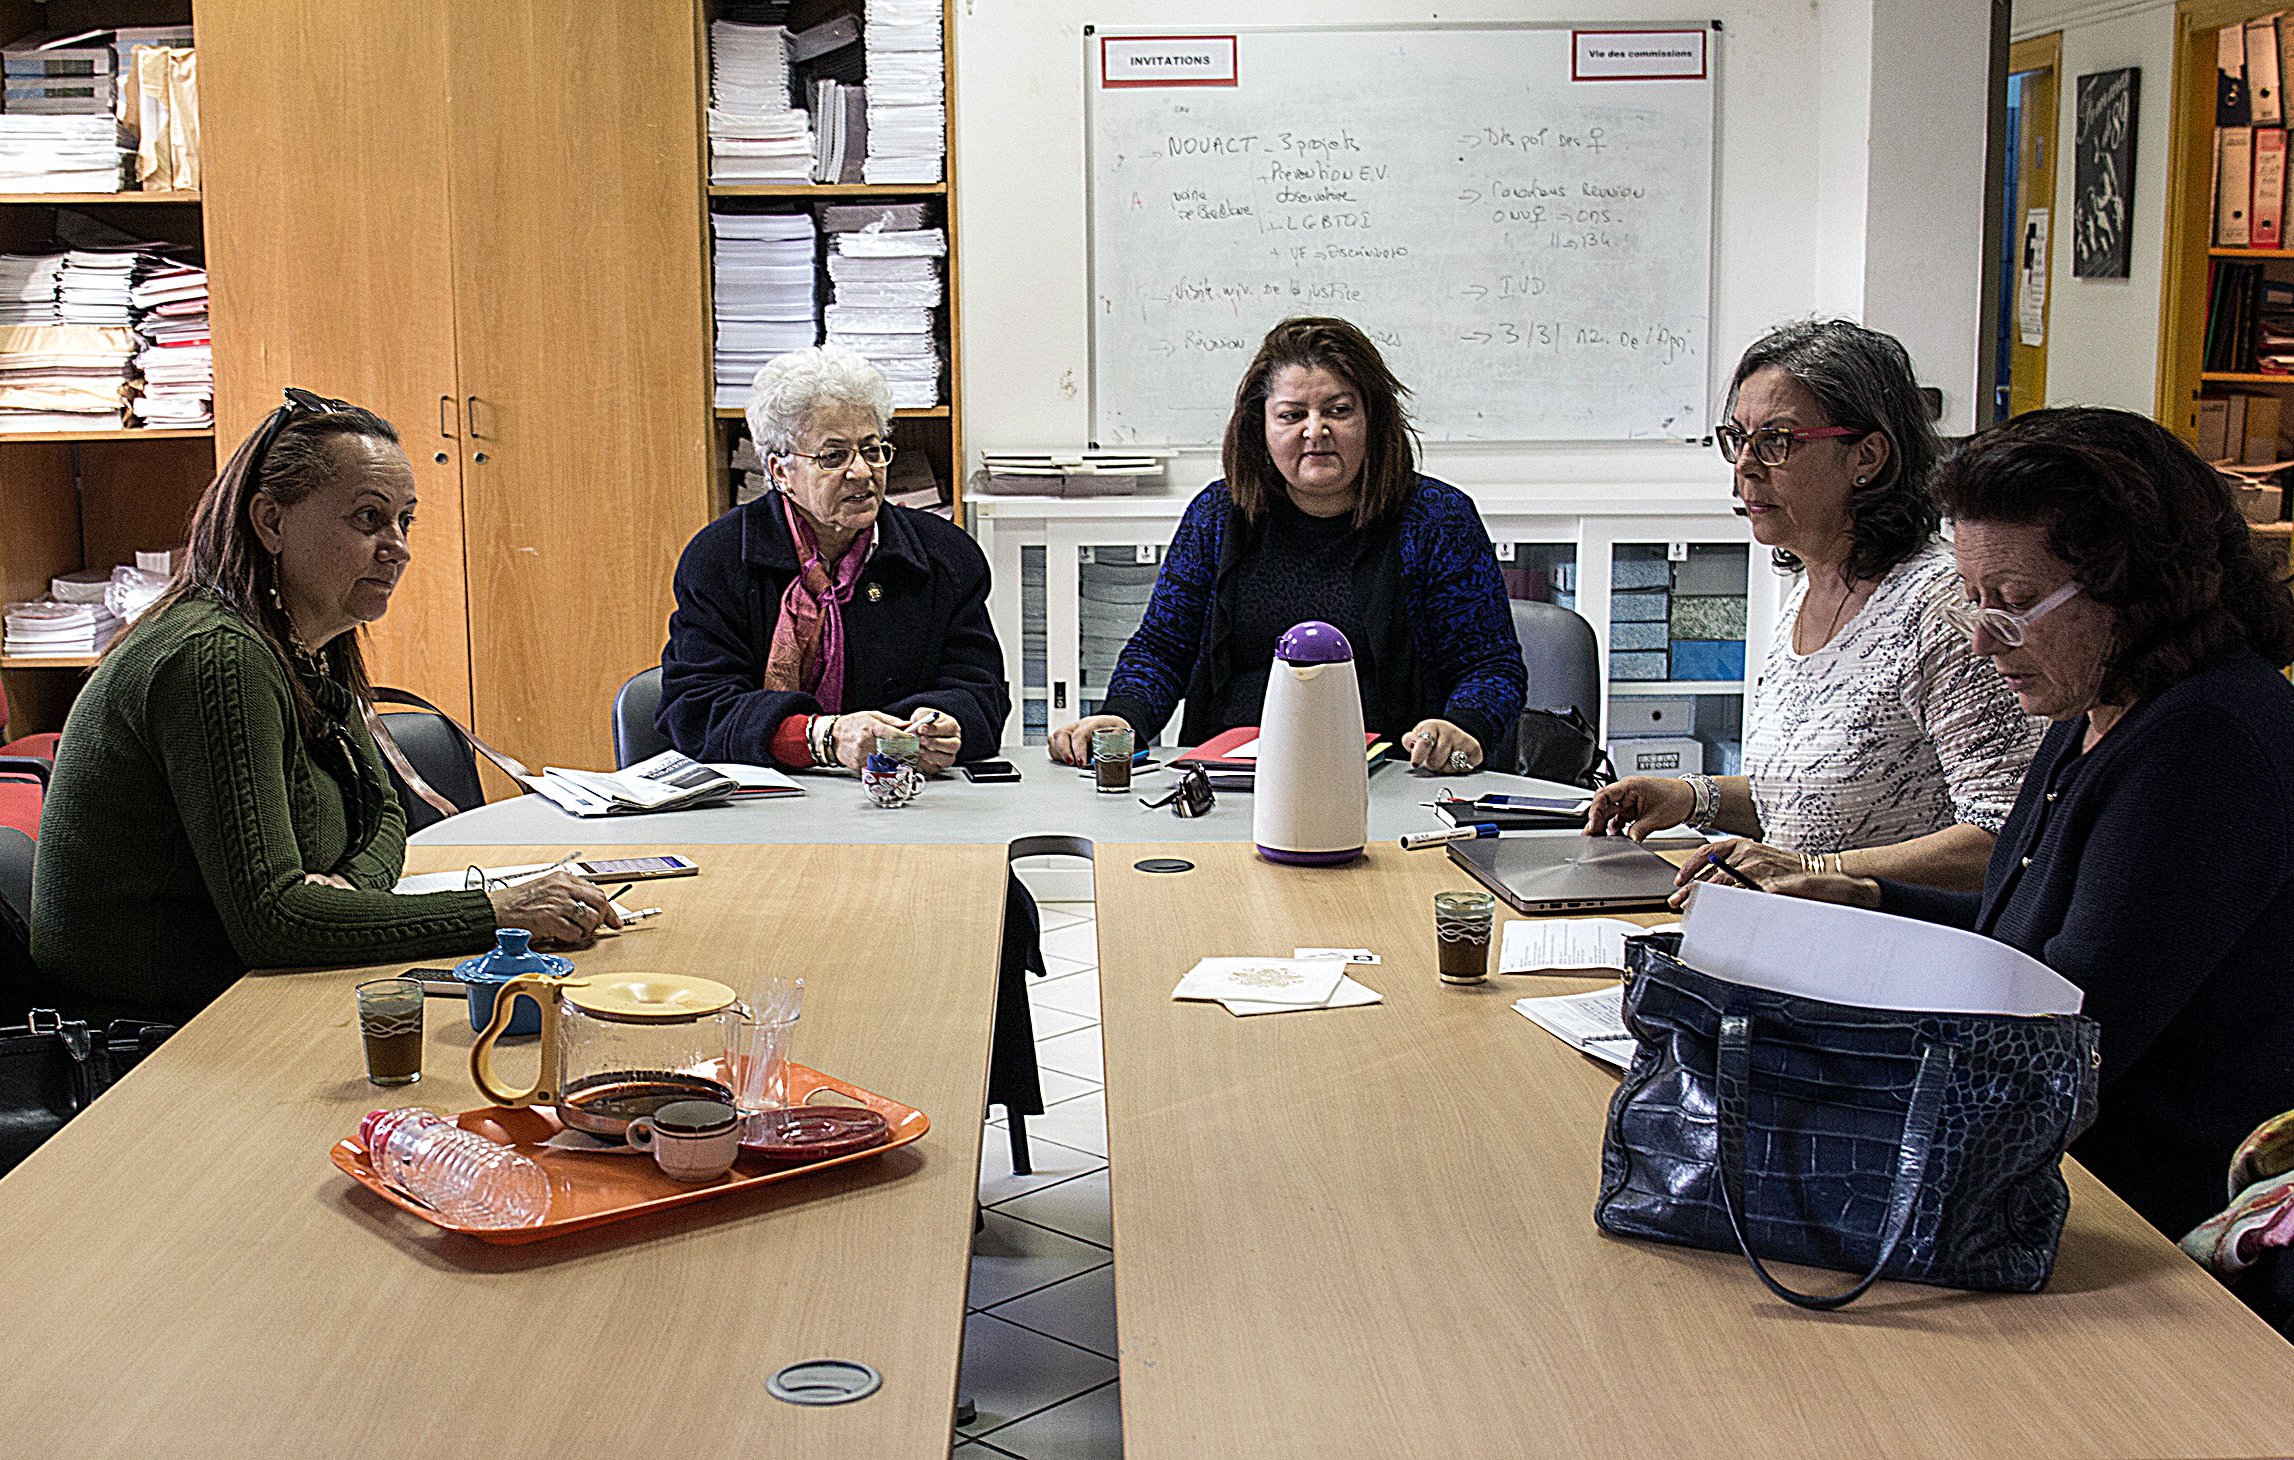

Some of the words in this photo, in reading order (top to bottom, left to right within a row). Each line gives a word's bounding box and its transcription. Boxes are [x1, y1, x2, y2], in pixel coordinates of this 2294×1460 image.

[1588, 49, 1605, 58] Vie
[1607, 49, 1625, 58] des
[1628, 48, 1692, 58] commissions
[1130, 55, 1210, 67] INVITATIONS
